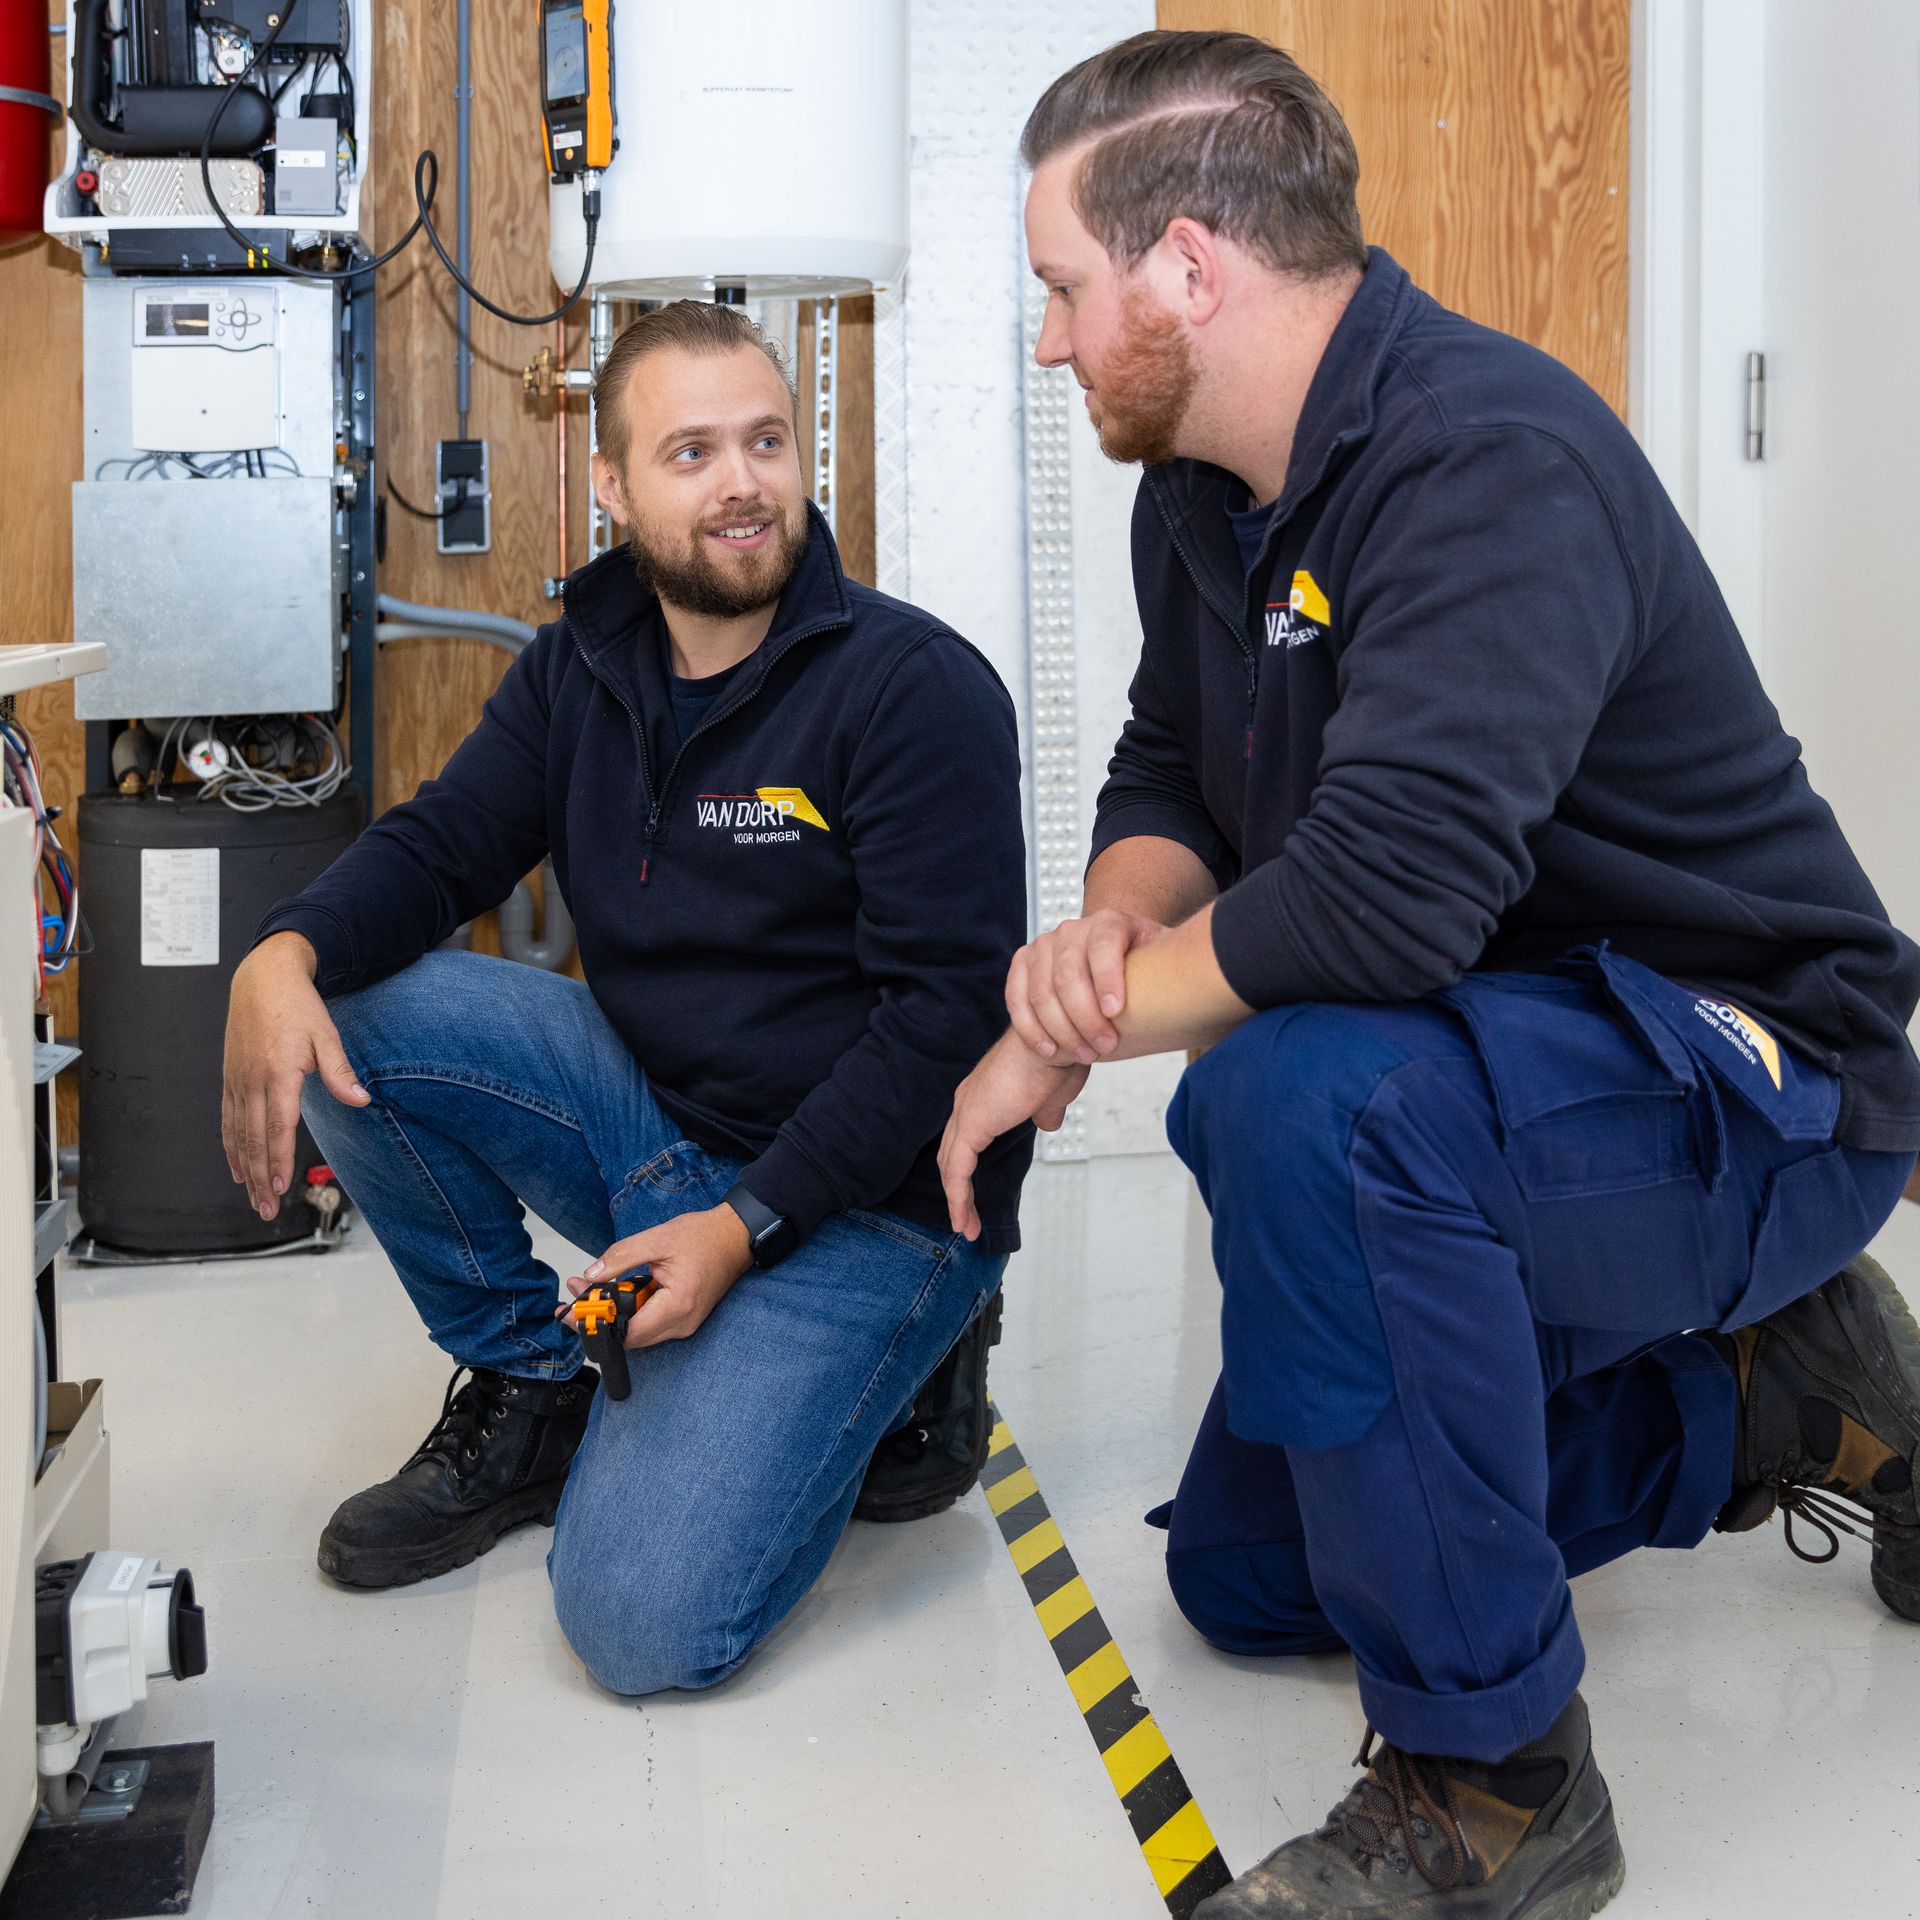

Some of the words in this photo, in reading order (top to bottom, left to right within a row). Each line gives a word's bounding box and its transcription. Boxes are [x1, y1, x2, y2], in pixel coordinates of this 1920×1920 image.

[1265, 611, 1291, 646] VA
[697, 801, 734, 827] VAN
[735, 800, 795, 827] DORP
[734, 833, 754, 844] VOOR
[756, 830, 800, 844] MORGEN
[1694, 1003, 1720, 1028] VOOR
[1718, 1025, 1758, 1065] MORGEN
